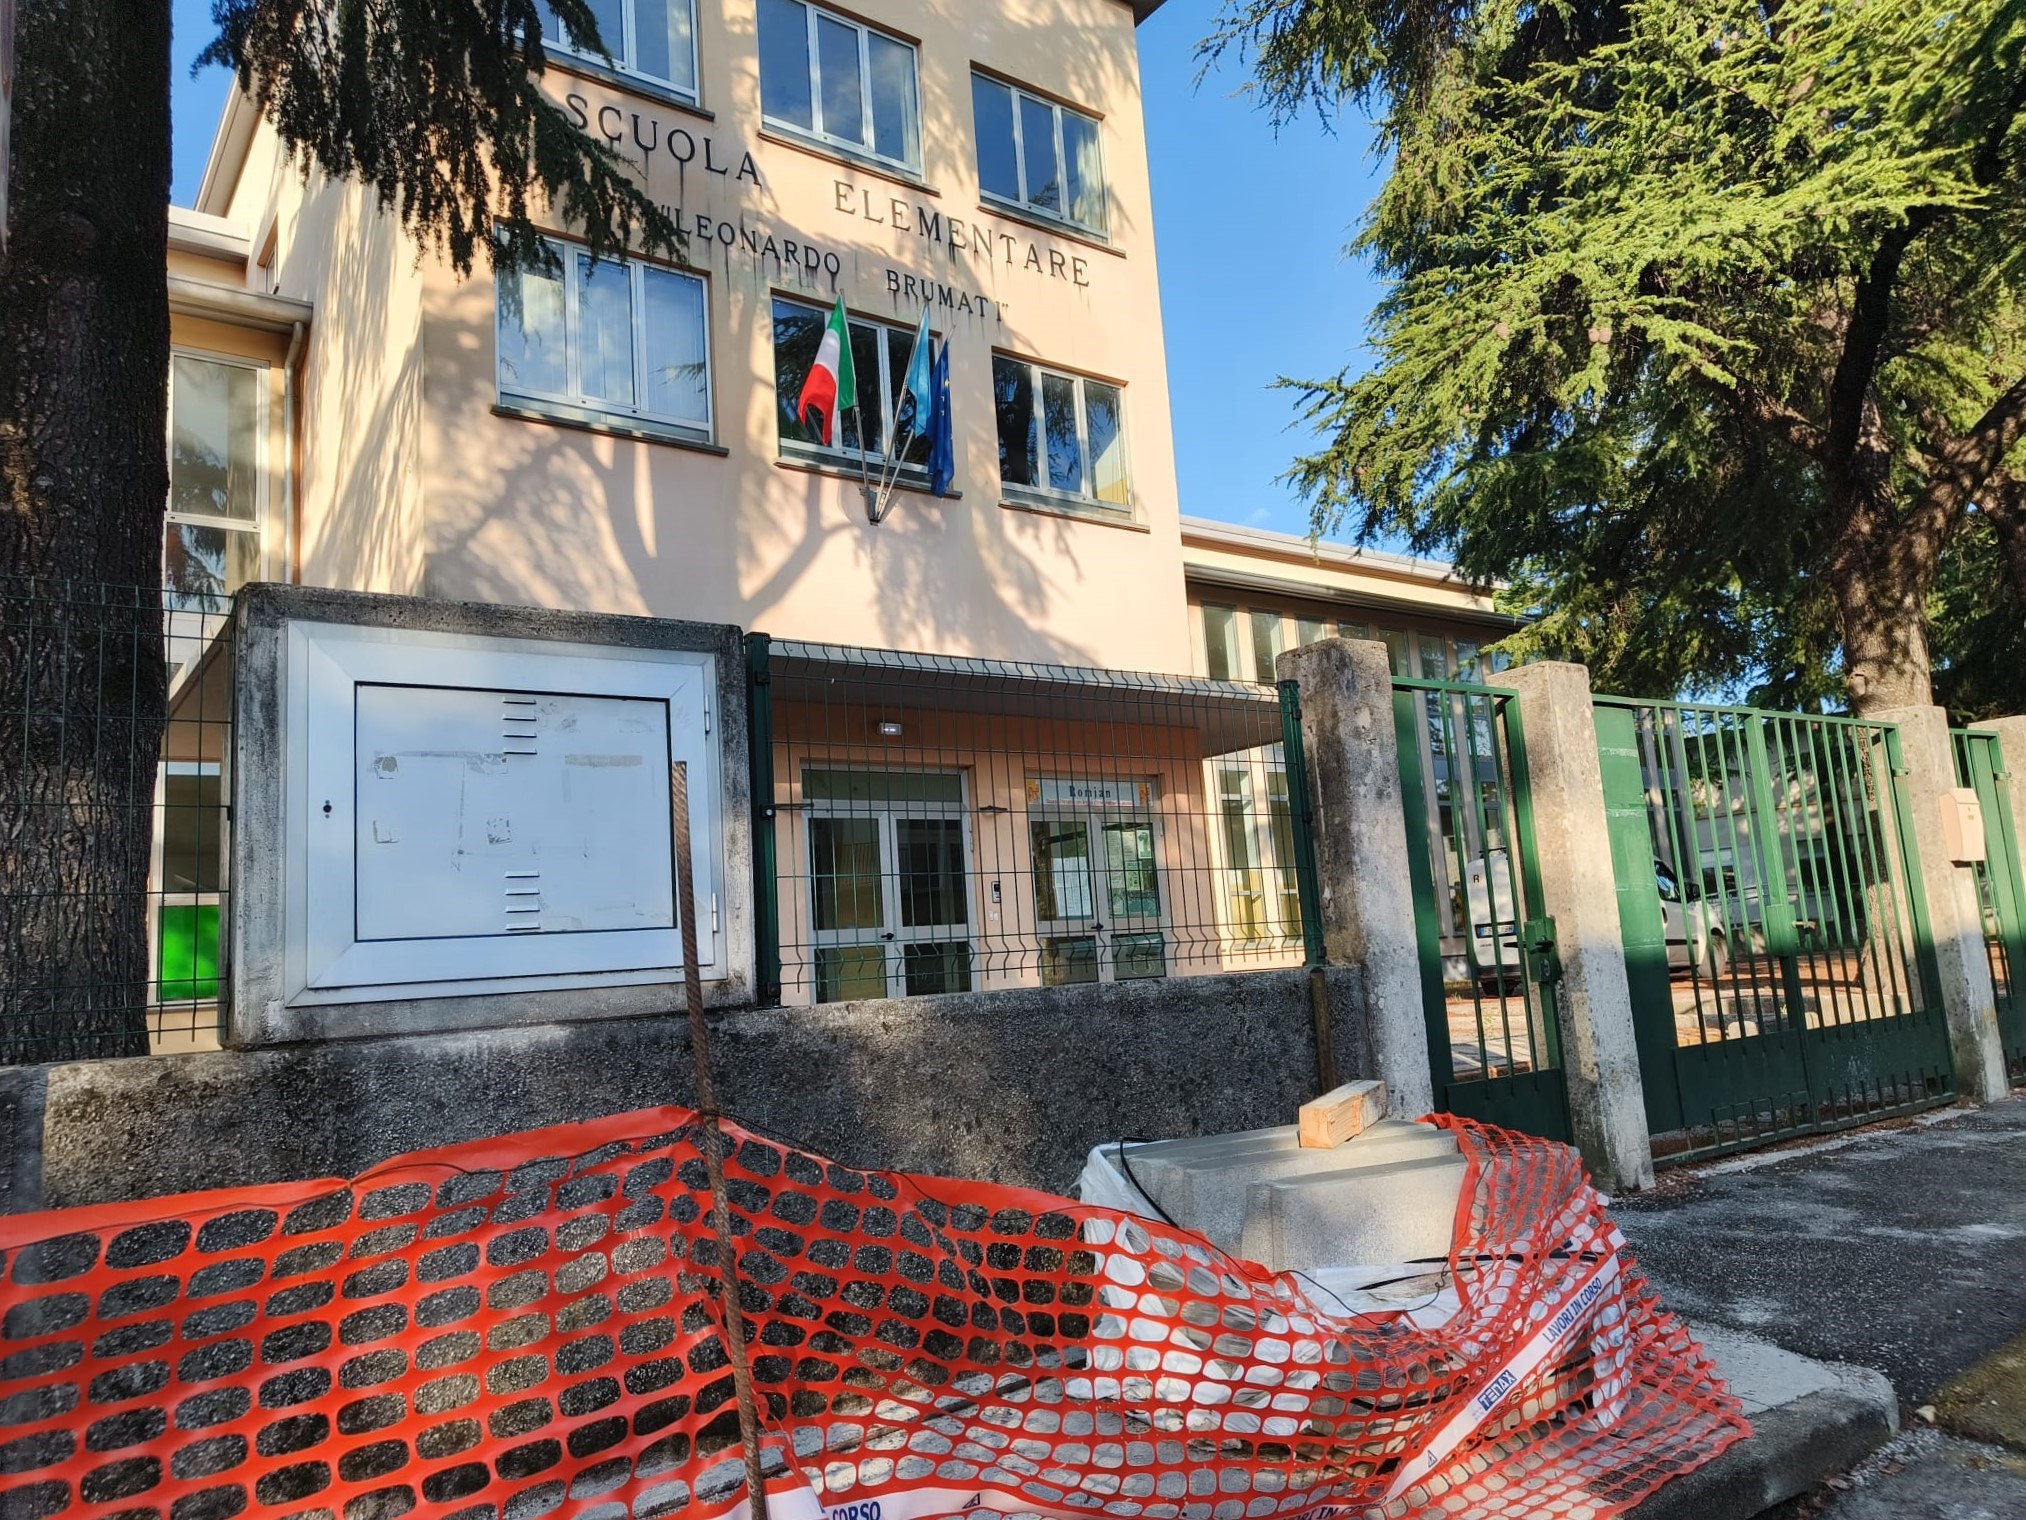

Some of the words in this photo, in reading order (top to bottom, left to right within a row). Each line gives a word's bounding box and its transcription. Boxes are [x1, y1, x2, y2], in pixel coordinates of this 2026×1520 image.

[565, 93, 763, 187] SCUOLA
[833, 179, 1090, 288] ELEMENTARE
[1542, 1308, 1575, 1343] LAVORI
[1570, 1299, 1582, 1316] IN
[1580, 1276, 1602, 1306] CORSO
